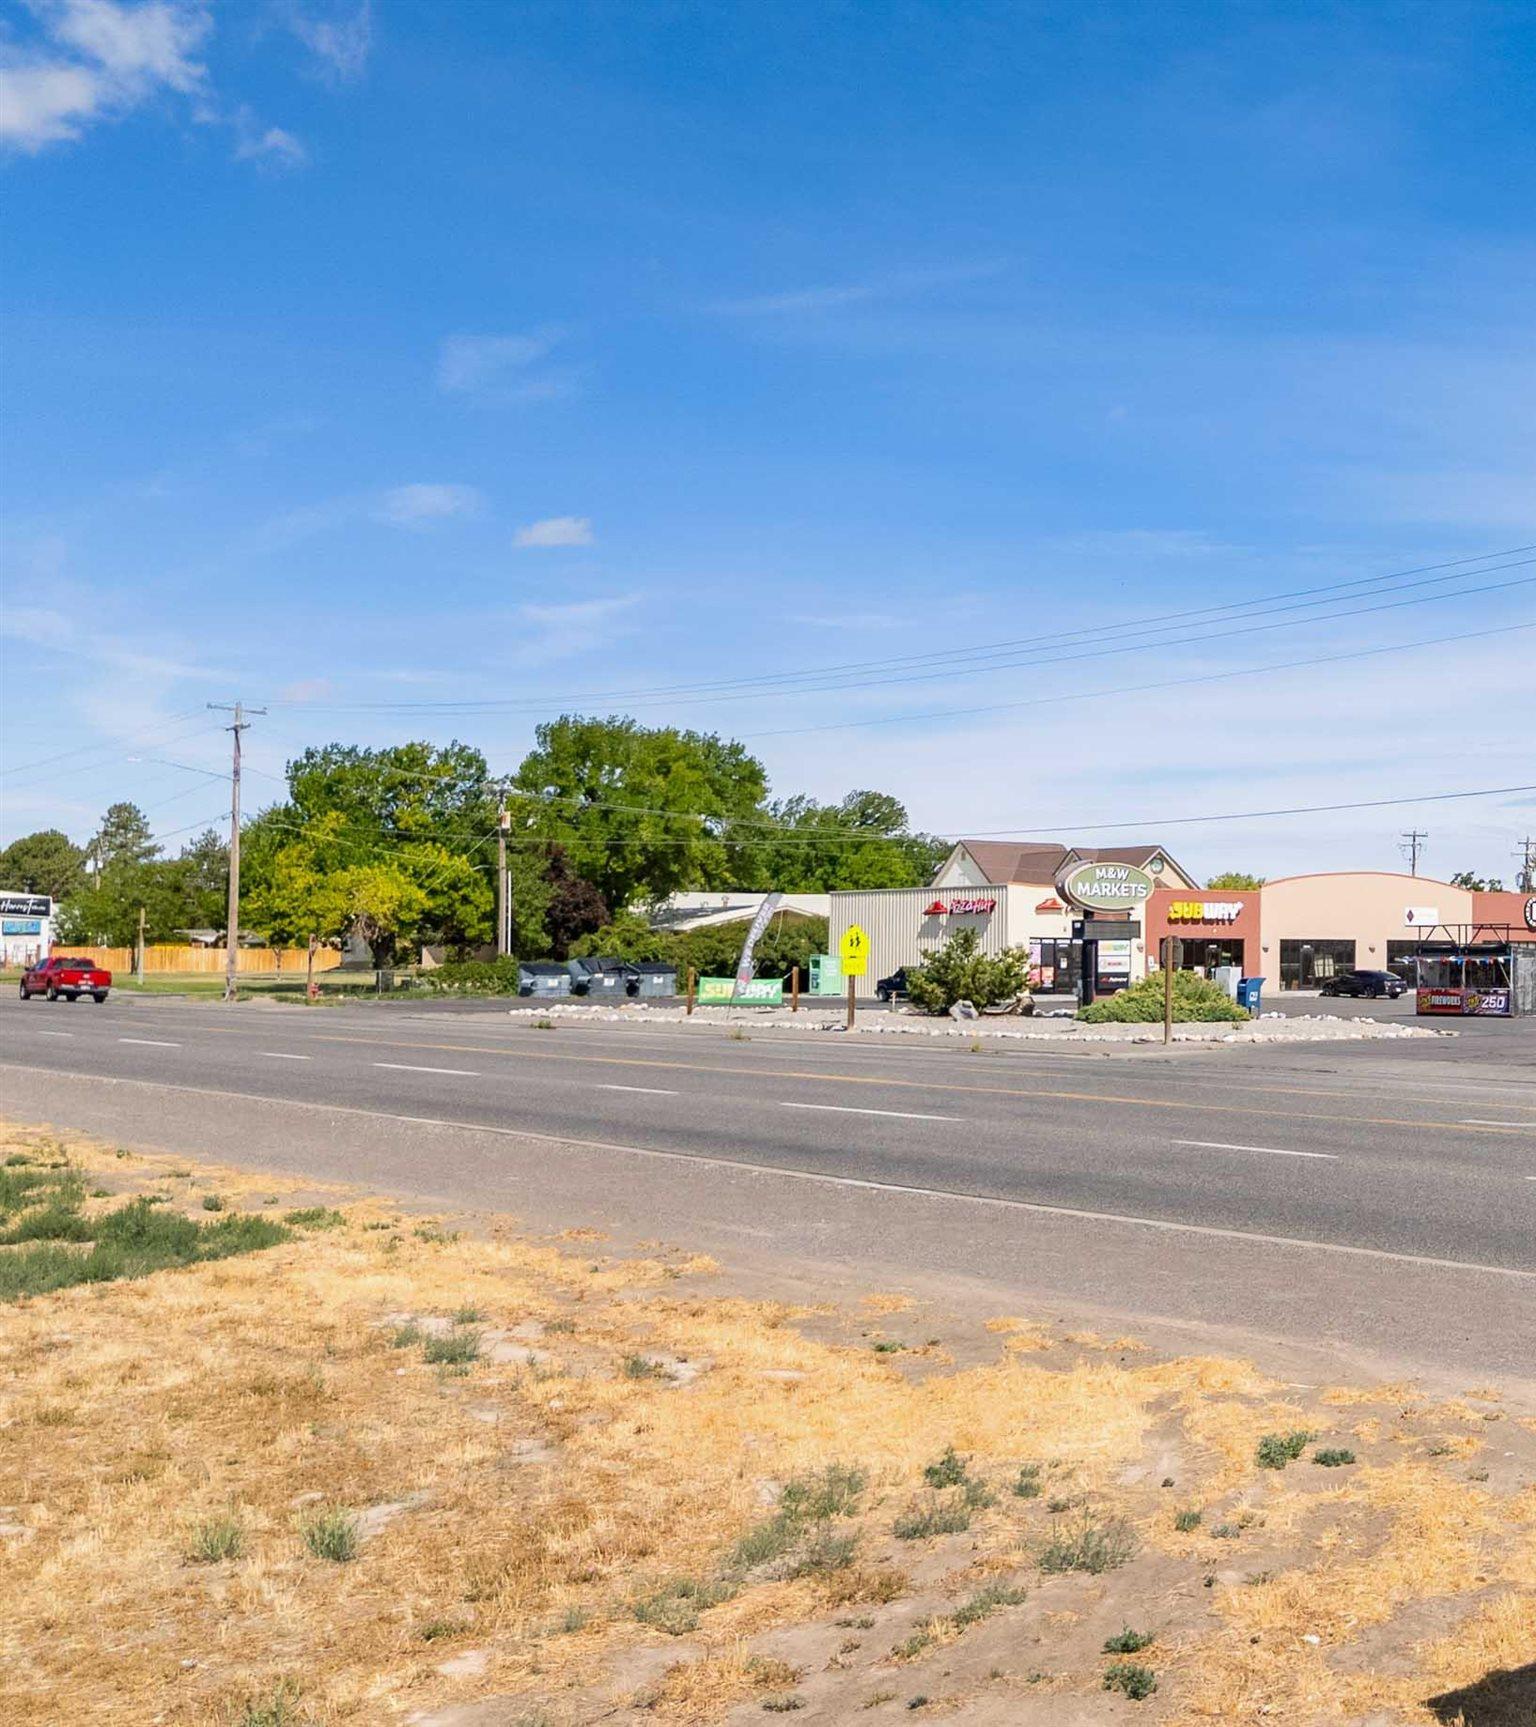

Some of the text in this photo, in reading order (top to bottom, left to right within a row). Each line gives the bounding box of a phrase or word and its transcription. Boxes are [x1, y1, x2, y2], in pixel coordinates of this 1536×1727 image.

[1095, 867, 1129, 880] M&W
[1077, 882, 1148, 898] MARKETS
[1168, 901, 1244, 920] SUBWAY
[1481, 996, 1505, 1009] 250
